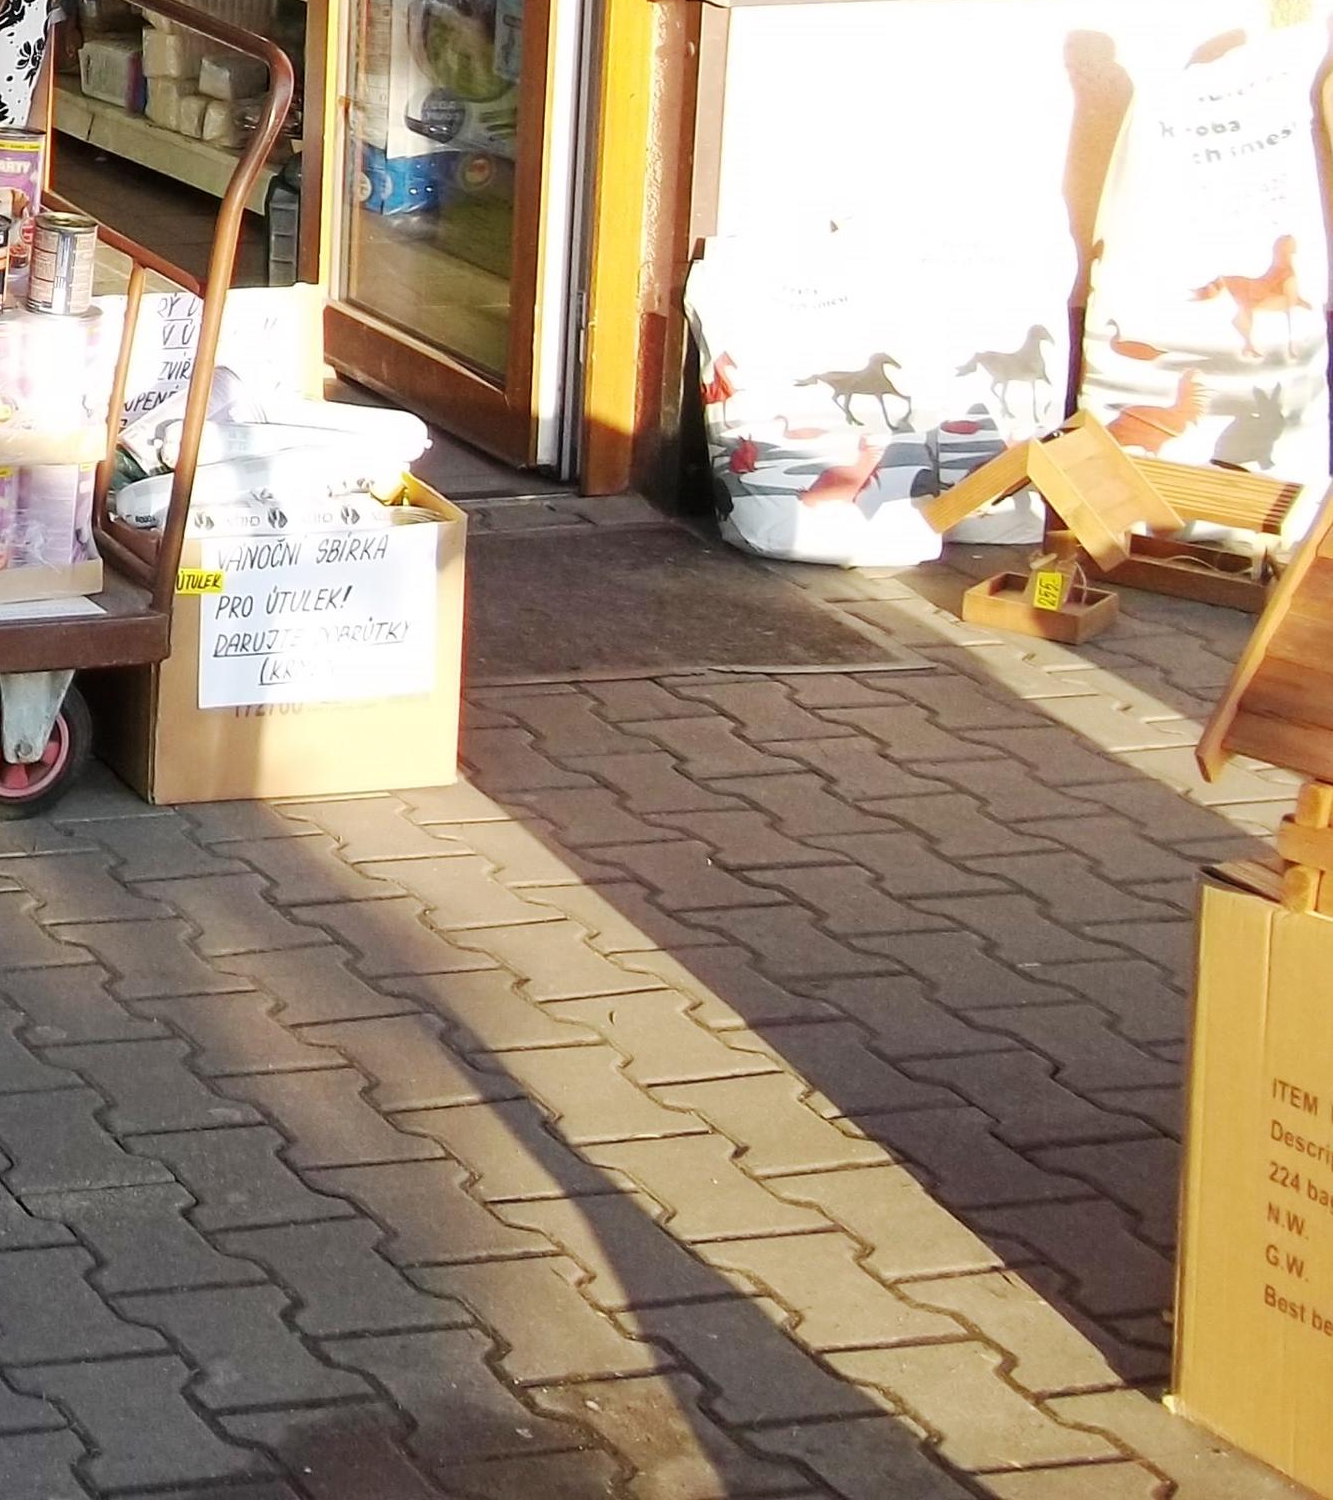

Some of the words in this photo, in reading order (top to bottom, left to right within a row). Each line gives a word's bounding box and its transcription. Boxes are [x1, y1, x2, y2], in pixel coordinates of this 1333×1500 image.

[316, 532, 389, 564] SBÍRKA
[216, 595, 254, 620] PRO
[266, 585, 353, 615] ÚTULEK!
[1272, 1077, 1319, 1116] ITEM
[1269, 1161, 1300, 1194] 224
[1268, 1201, 1310, 1240] N.W.
[1266, 1244, 1310, 1283] G.W.
[1264, 1284, 1306, 1324] Best
